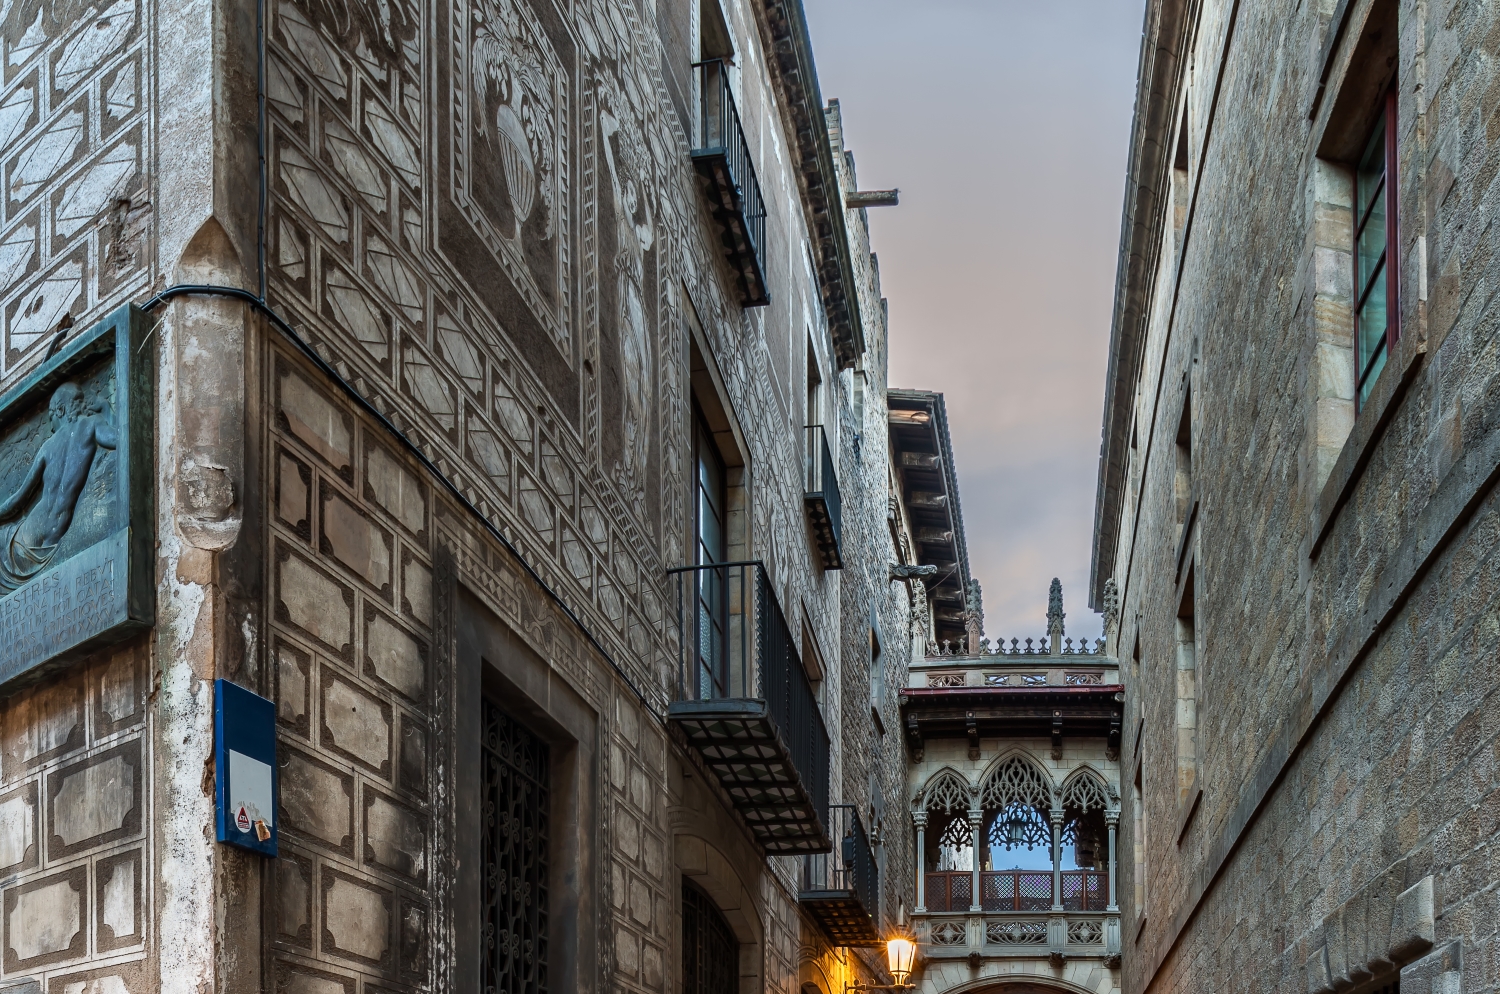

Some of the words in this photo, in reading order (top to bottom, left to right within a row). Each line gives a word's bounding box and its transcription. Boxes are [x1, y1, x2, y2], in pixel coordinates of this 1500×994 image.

[53, 582, 70, 603] HA
[35, 609, 47, 628] DE
[51, 596, 71, 618] TOT
